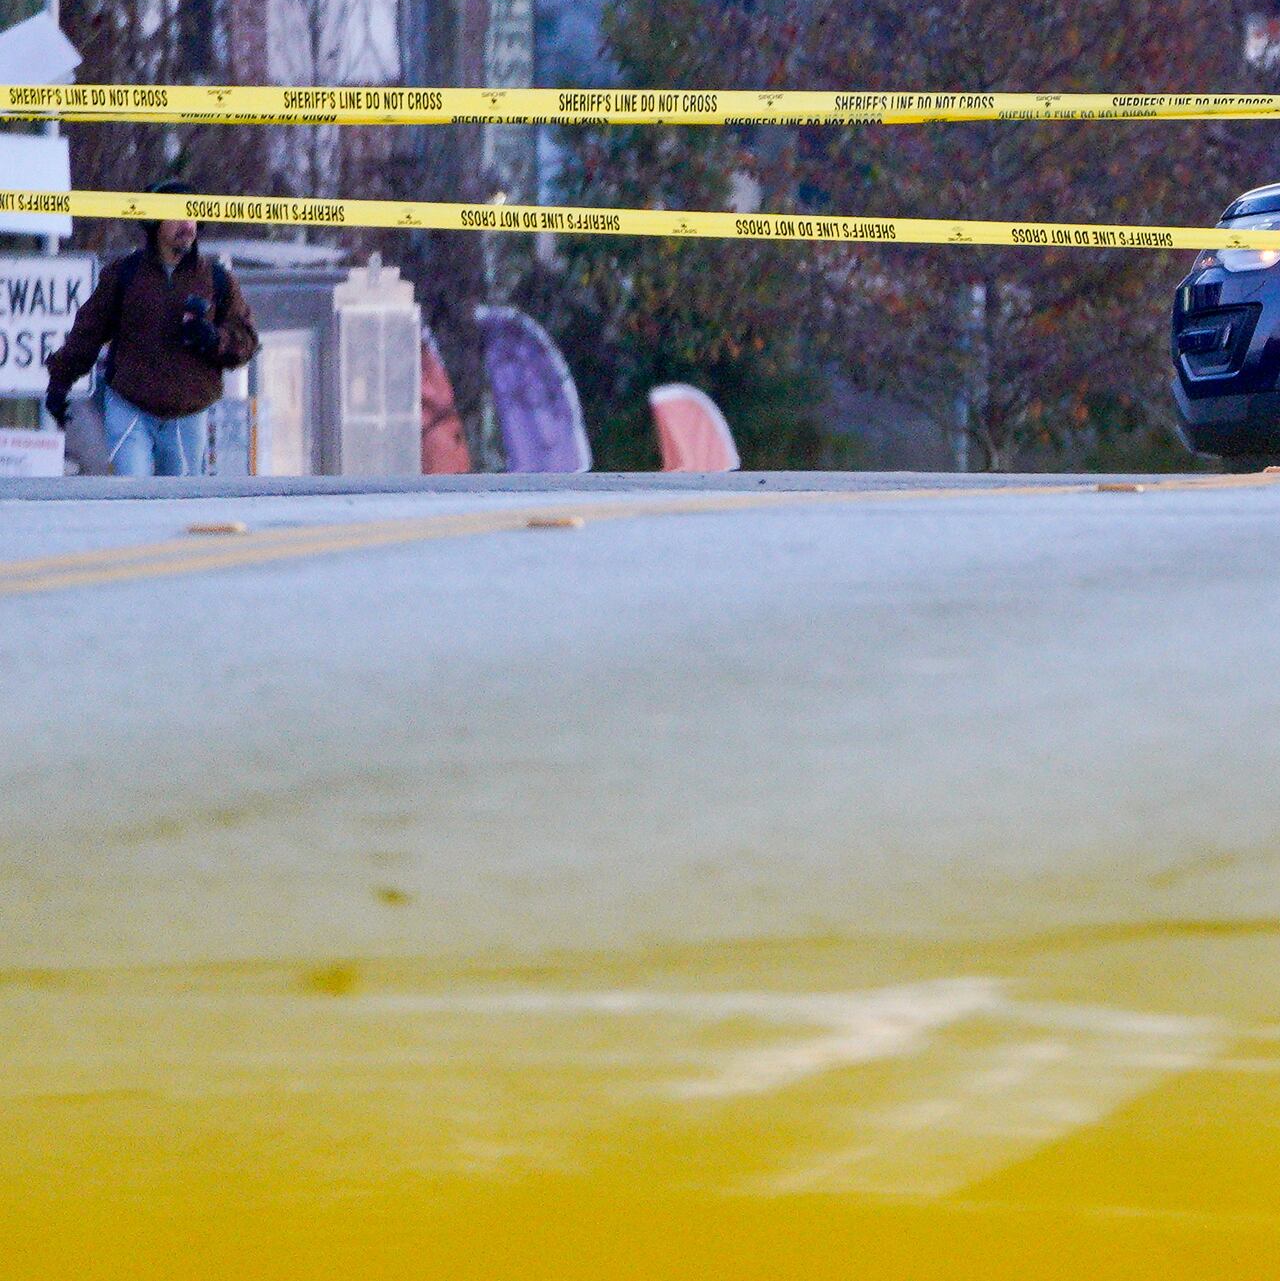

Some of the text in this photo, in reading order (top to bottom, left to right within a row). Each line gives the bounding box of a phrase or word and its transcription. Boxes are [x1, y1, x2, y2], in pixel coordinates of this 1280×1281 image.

[9, 89, 169, 106] SHERIFF'S LINE DO NOT CROSS
[283, 91, 442, 110] SHERIFF'S LINE DO NOT CROSS
[558, 93, 718, 113] SHERIFF'S LINE DO NOT CROSS
[19, 195, 70, 213] SHERIFF'S
[185, 200, 345, 222] SHERIFF'S LINE DO NOT CROSS
[460, 210, 621, 231] SHERIFF'S LINE DO NOT CROSS
[736, 218, 897, 239] SHERIFF'S LINE DO NOT CROSS
[1011, 228, 1173, 246] SHERIFF'S LINE DO NOT CROSS
